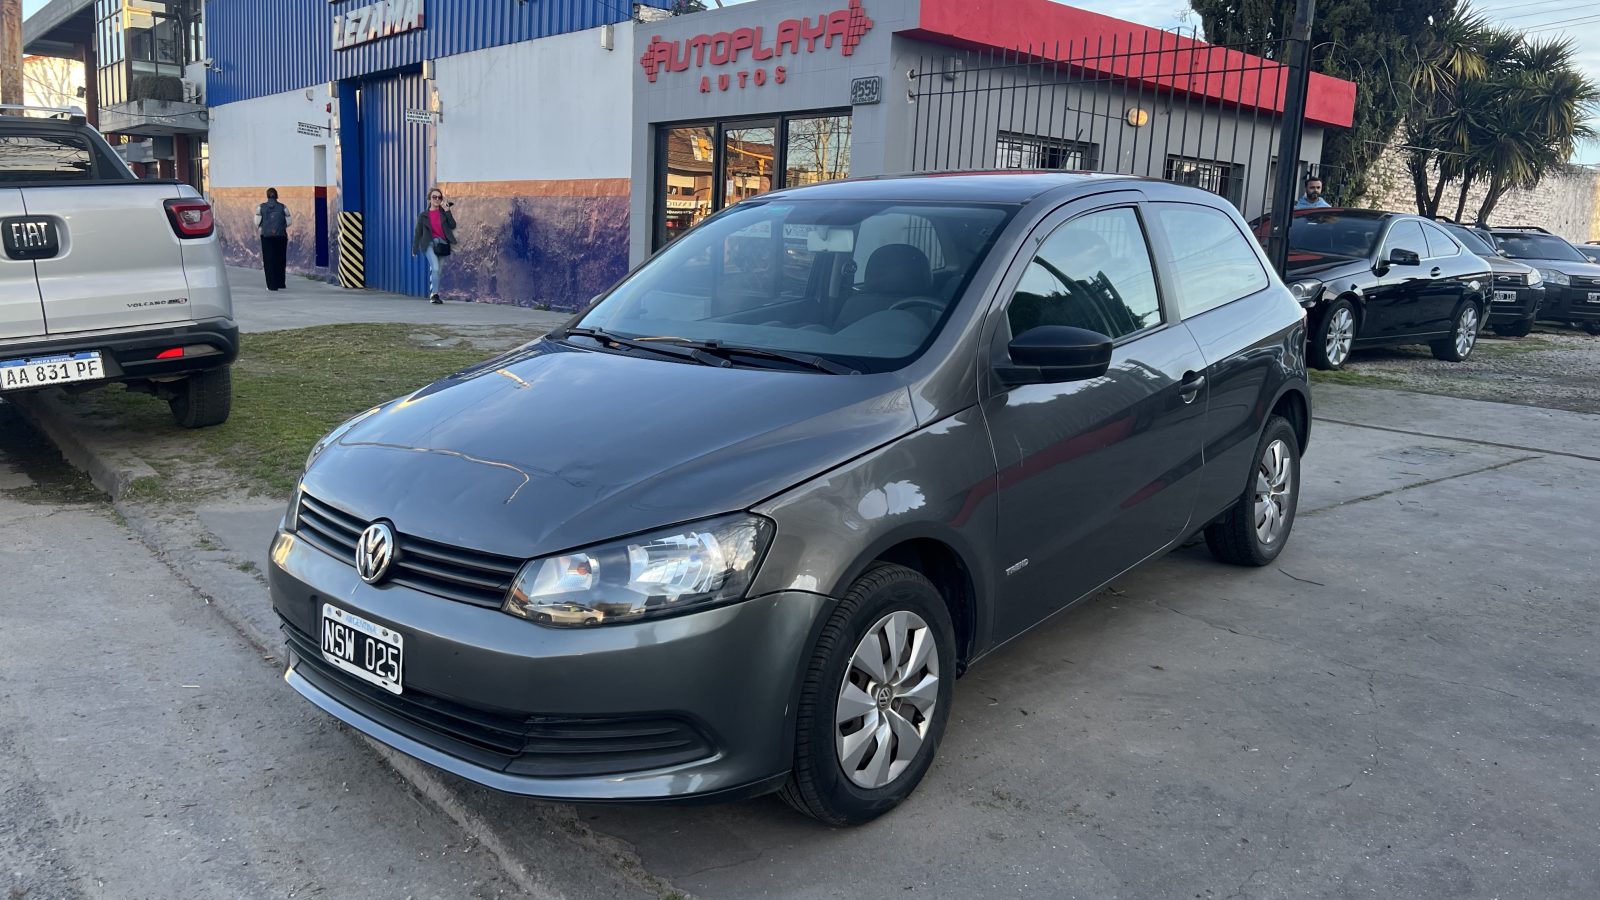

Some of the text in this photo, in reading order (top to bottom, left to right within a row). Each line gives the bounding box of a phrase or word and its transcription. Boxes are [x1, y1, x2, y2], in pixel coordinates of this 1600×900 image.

[333, 0, 424, 51] LEZAMA
[653, 9, 853, 74] AUTOPLAYA
[700, 66, 786, 93] AUTOS
[851, 79, 877, 97] 4550
[11, 221, 48, 248] FIAT
[126, 300, 167, 308] VOLCANO
[7, 360, 97, 385] AA 831 PF
[325, 619, 398, 682] NSW 025
